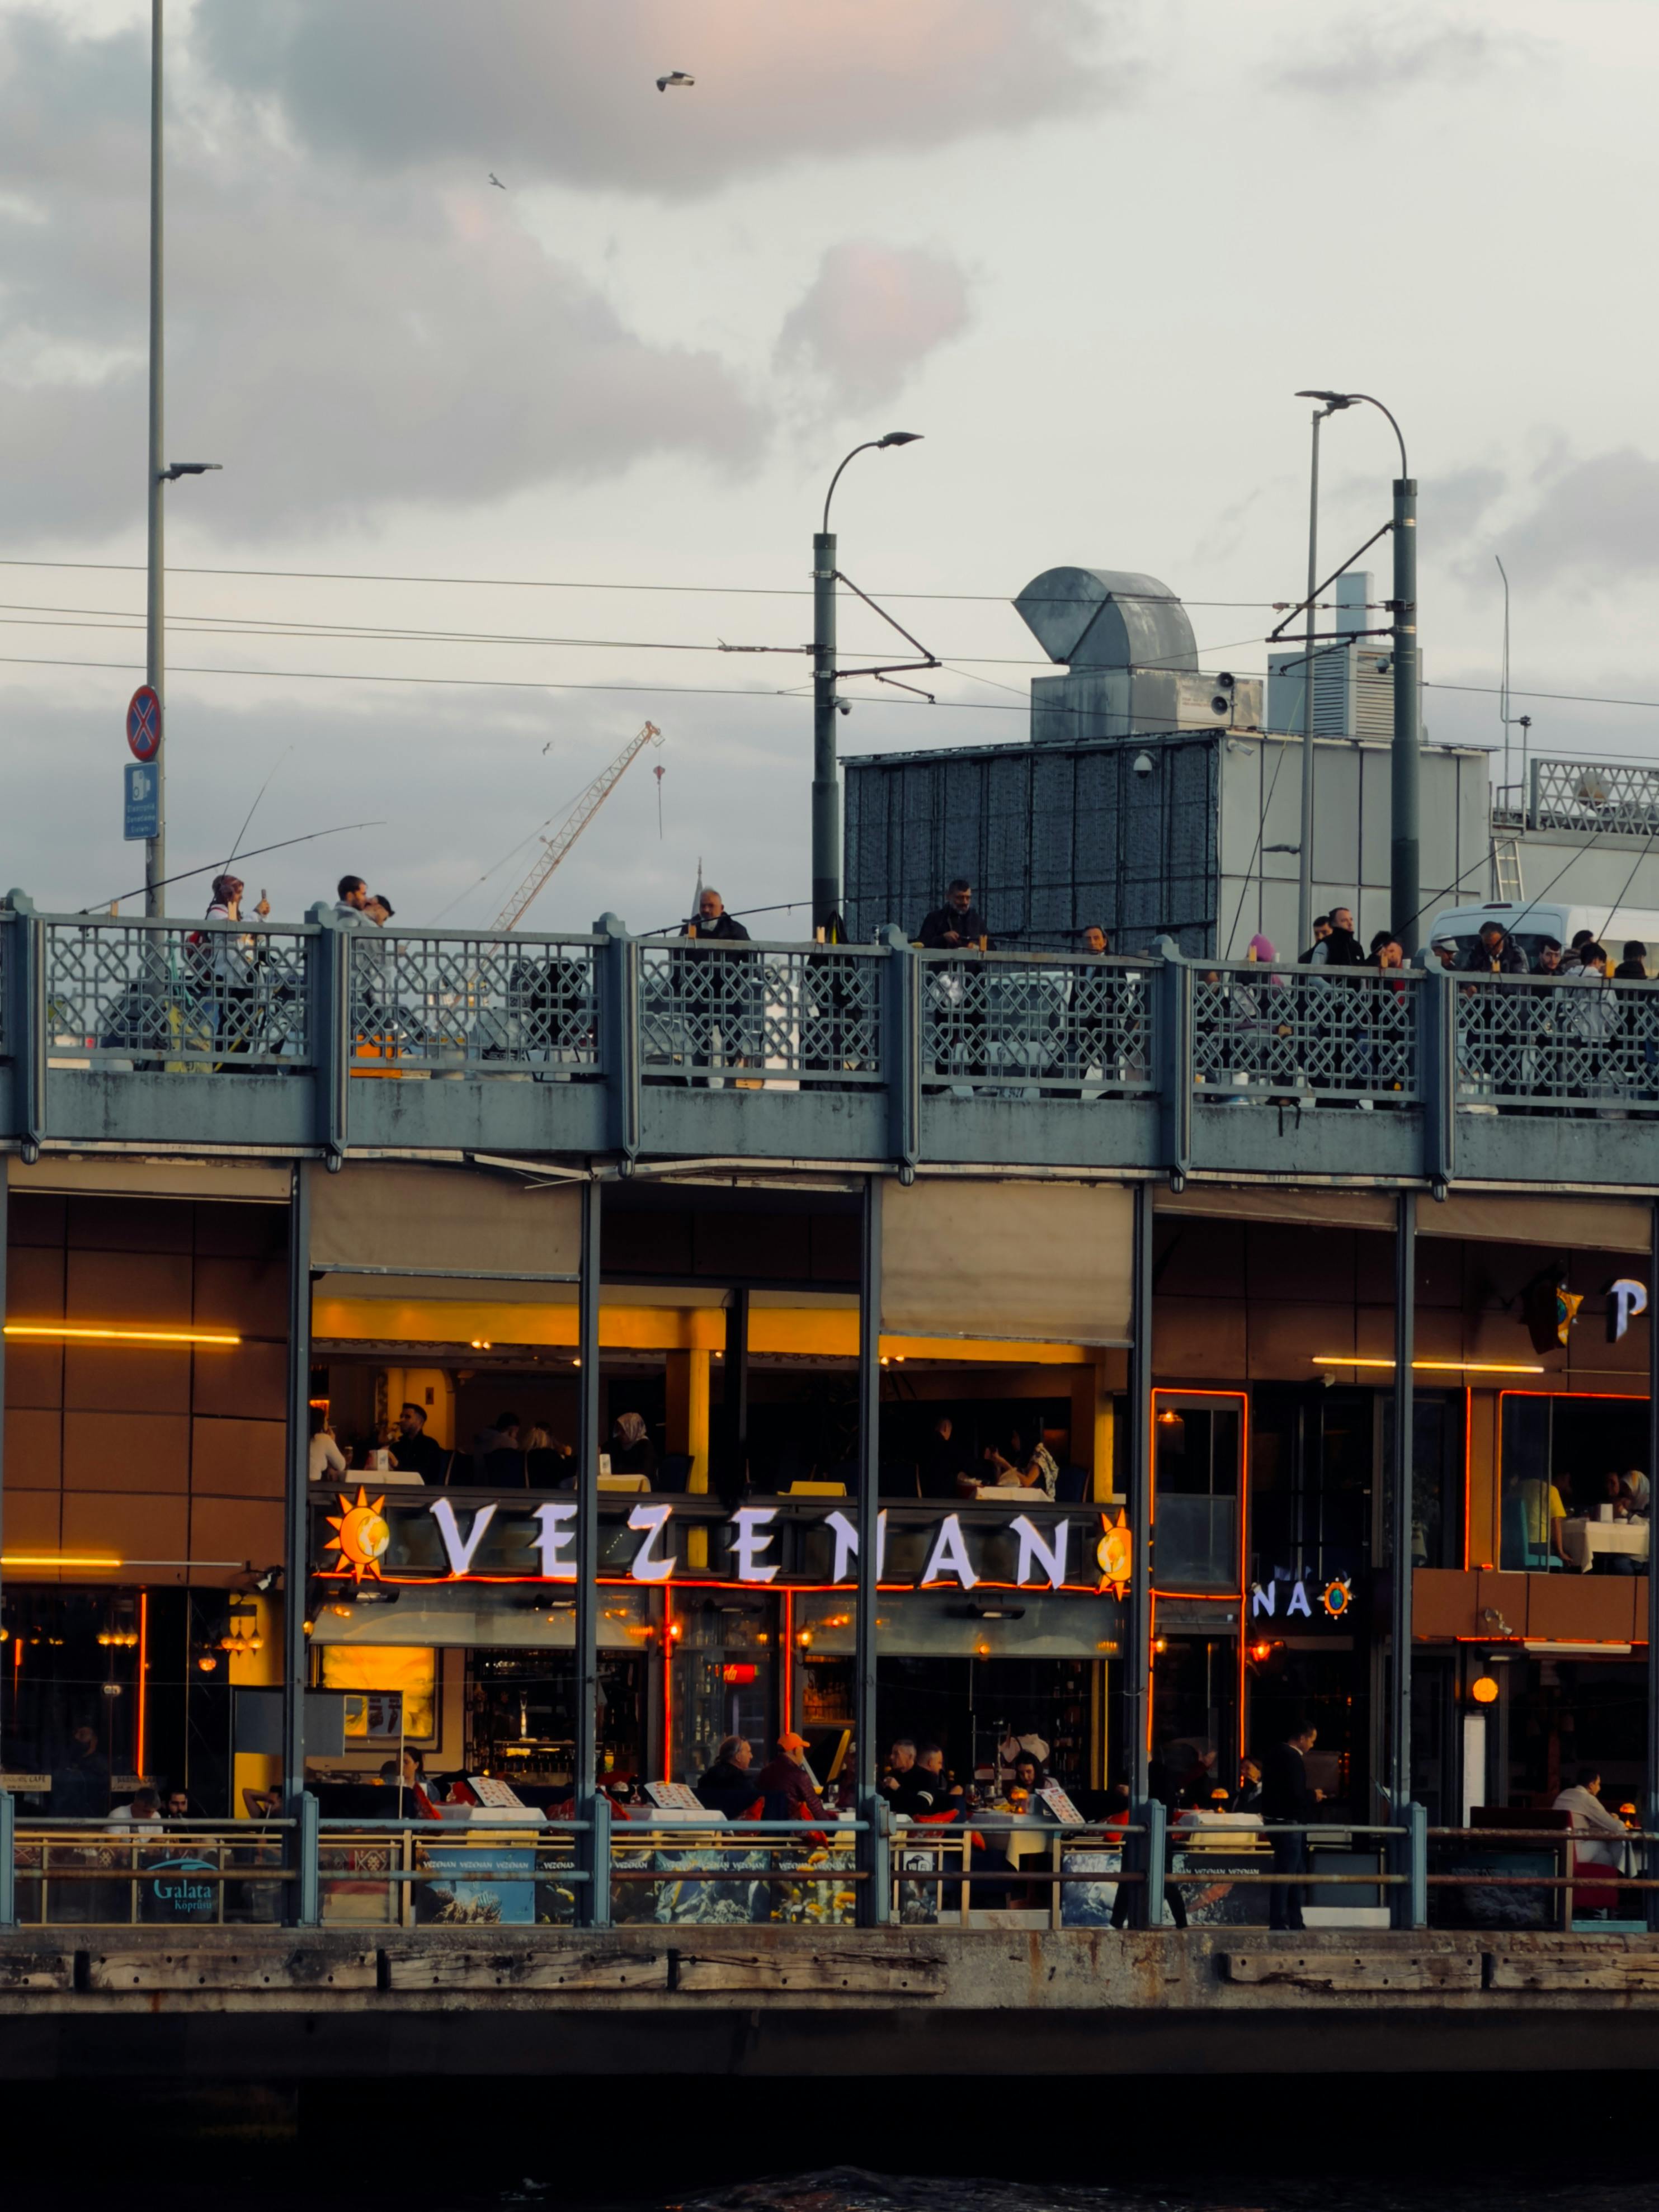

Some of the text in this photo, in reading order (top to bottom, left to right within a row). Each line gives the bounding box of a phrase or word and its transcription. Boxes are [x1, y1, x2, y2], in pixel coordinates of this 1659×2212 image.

[1606, 1279, 1648, 1341] P
[430, 1497, 1069, 1590] VEZENAN
[153, 1879, 211, 1899] Galata
